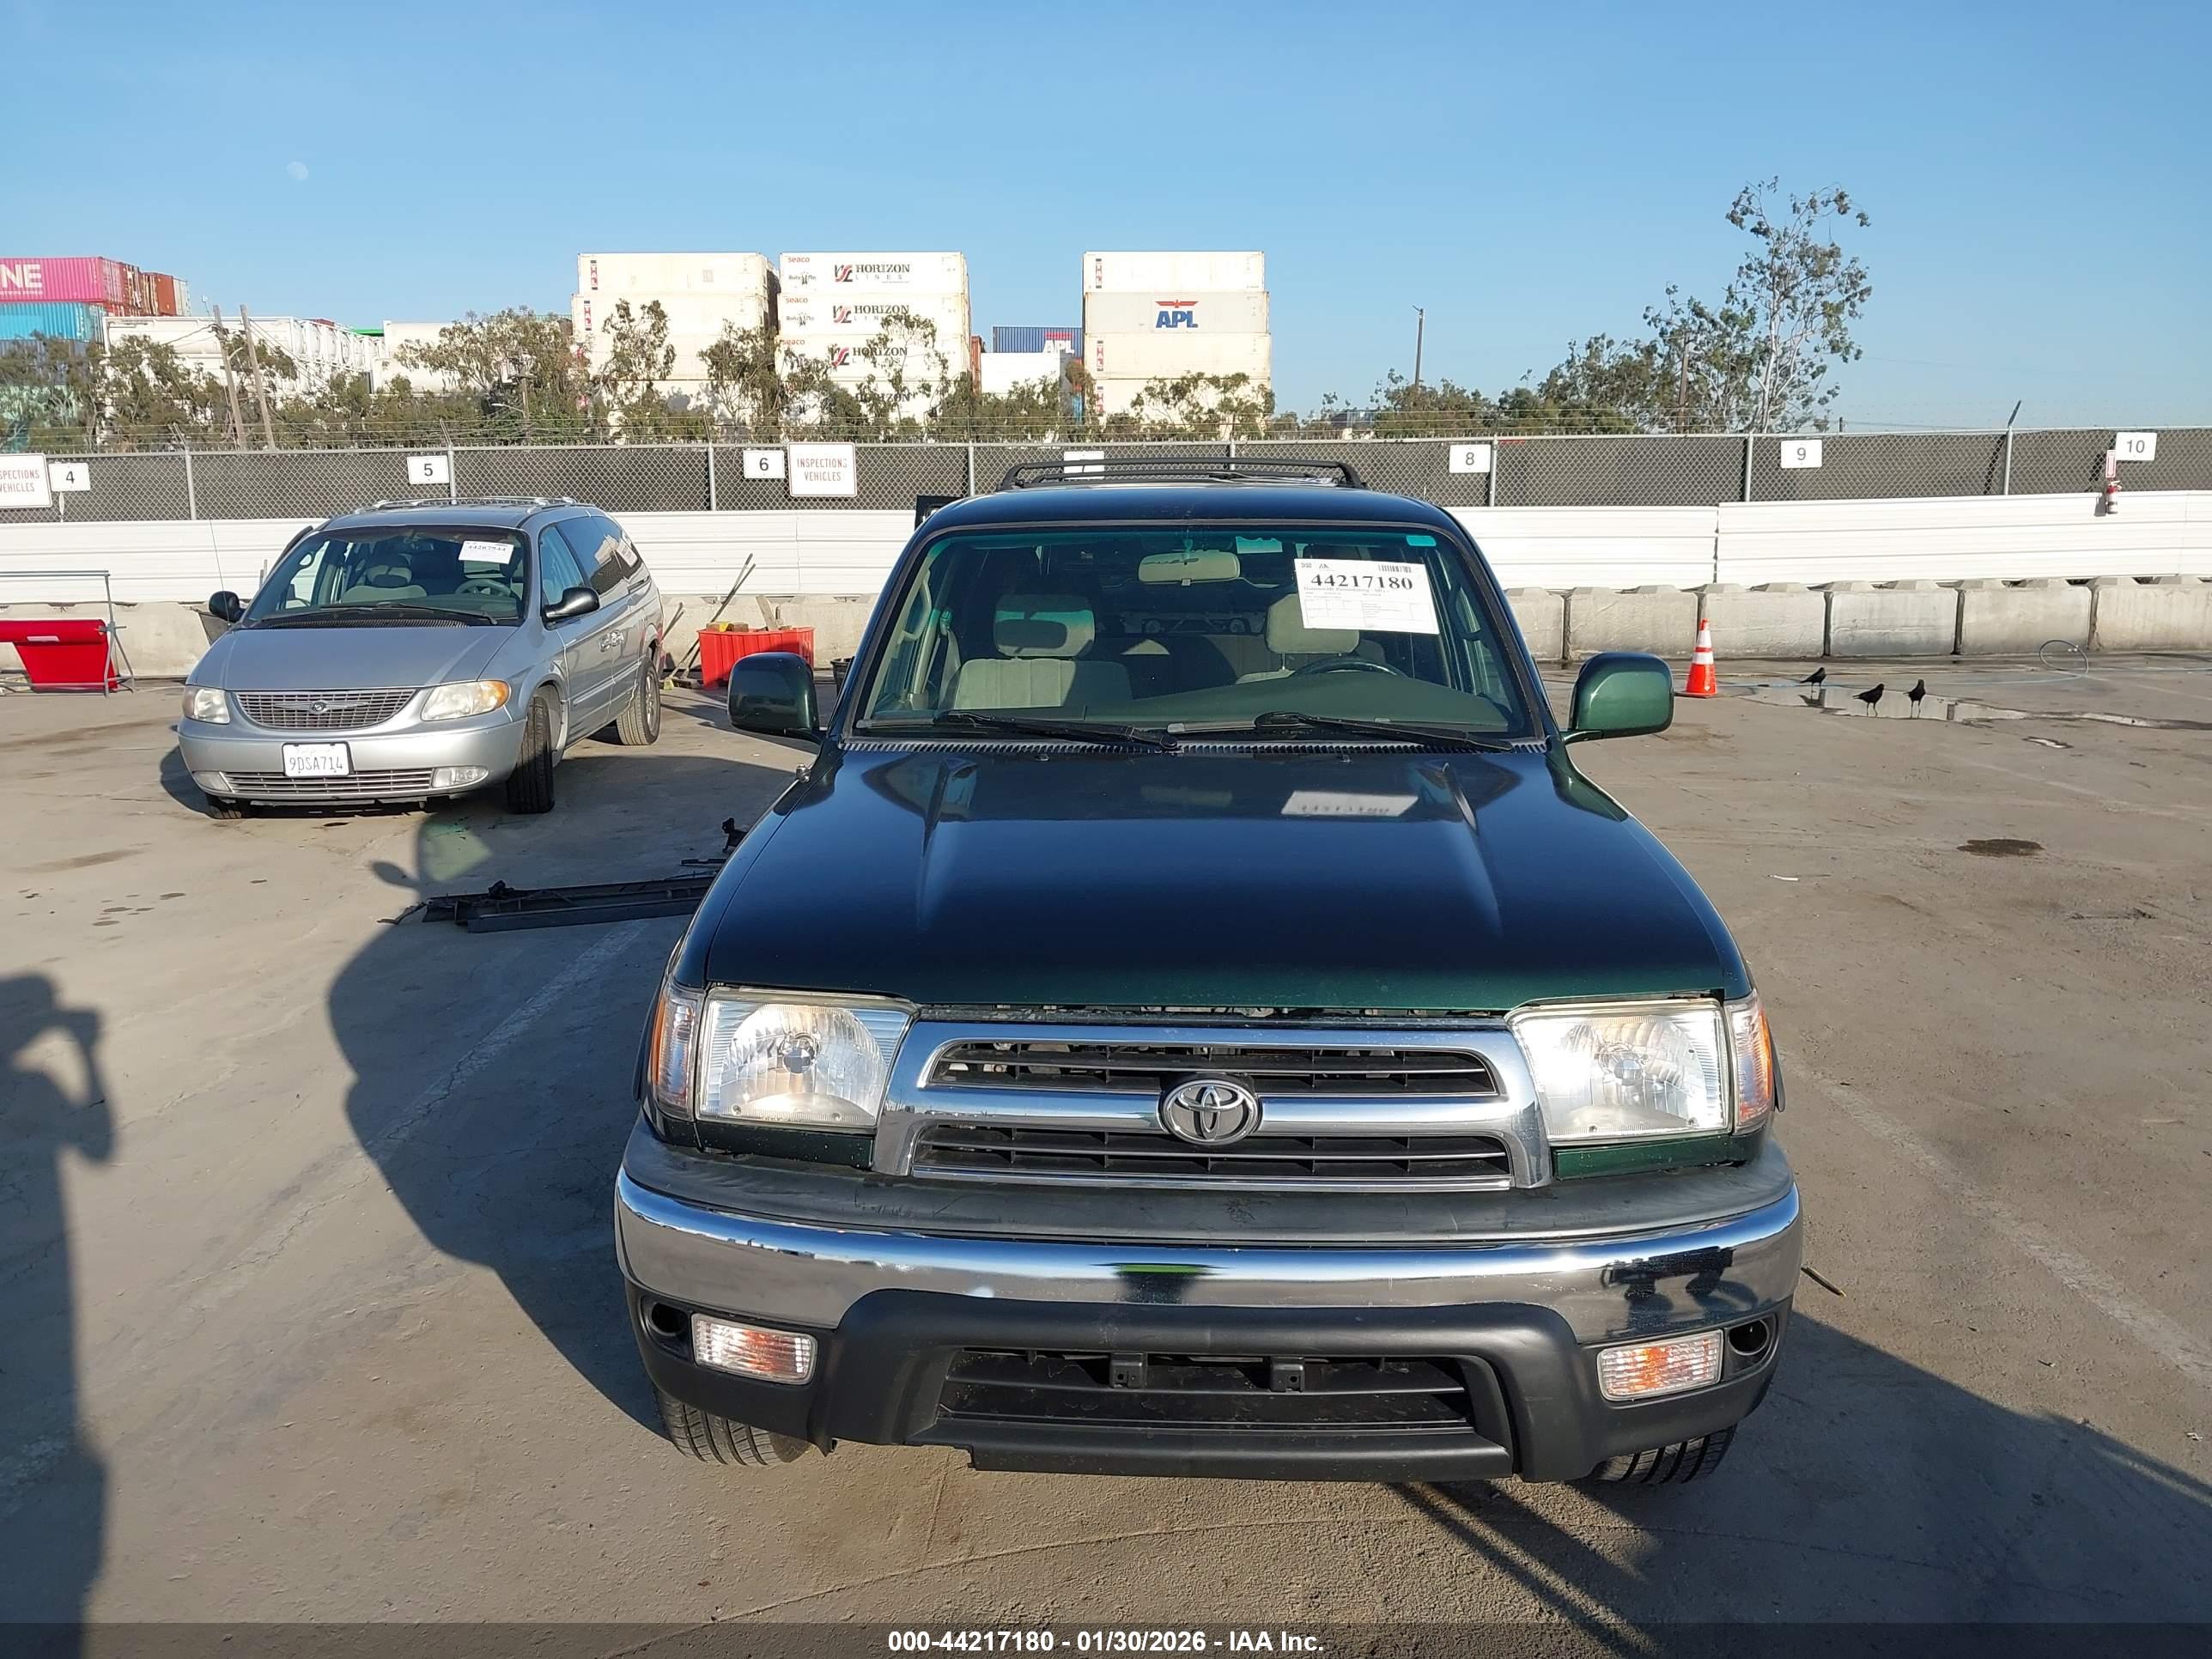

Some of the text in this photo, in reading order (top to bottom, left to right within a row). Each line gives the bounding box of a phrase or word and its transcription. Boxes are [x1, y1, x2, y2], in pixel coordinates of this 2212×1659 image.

[856, 264, 910, 273] HORIZON
[0, 264, 42, 288] NE
[854, 305, 909, 314] HORIZON
[1156, 311, 1199, 328] APL
[1042, 340, 1075, 355] APL
[2127, 440, 2145, 453] 10
[1465, 452, 1475, 465] 8
[1796, 447, 1807, 461] 9
[423, 463, 434, 477] 5
[759, 457, 769, 471] 6
[797, 458, 848, 468] INSPECTIONS
[65, 471, 75, 483] 4
[805, 471, 842, 481] VEHICLES
[1310, 574, 1413, 590] 44217180
[289, 756, 343, 771] 9DSA714
